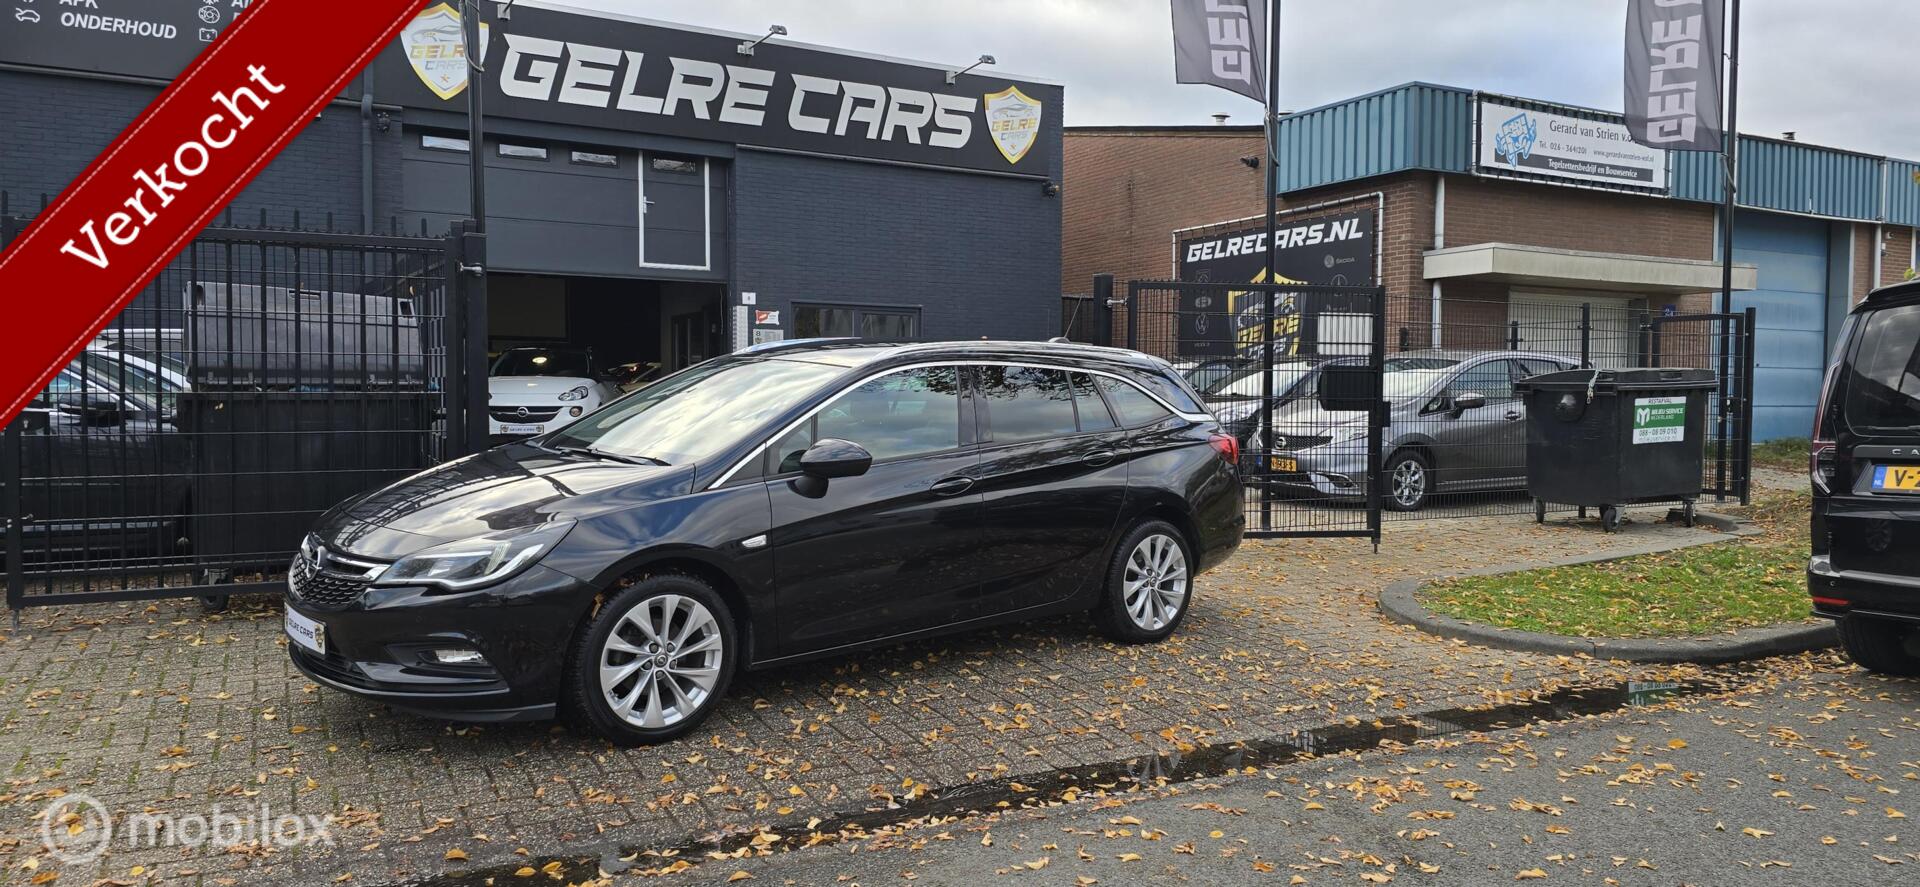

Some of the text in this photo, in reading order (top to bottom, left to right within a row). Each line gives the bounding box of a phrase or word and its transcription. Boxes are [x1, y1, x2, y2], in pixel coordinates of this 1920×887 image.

[60, 12, 177, 39] ONDERHOUD
[410, 44, 466, 59] GELR
[1646, 14, 1702, 143] GELRE
[499, 33, 977, 149] GELRE CARS
[992, 117, 1037, 132] GELRE
[1549, 120, 1578, 135] Gerard
[1580, 128, 1594, 137] van
[1596, 127, 1619, 141] Strien
[1605, 166, 1638, 178] Bouwservice
